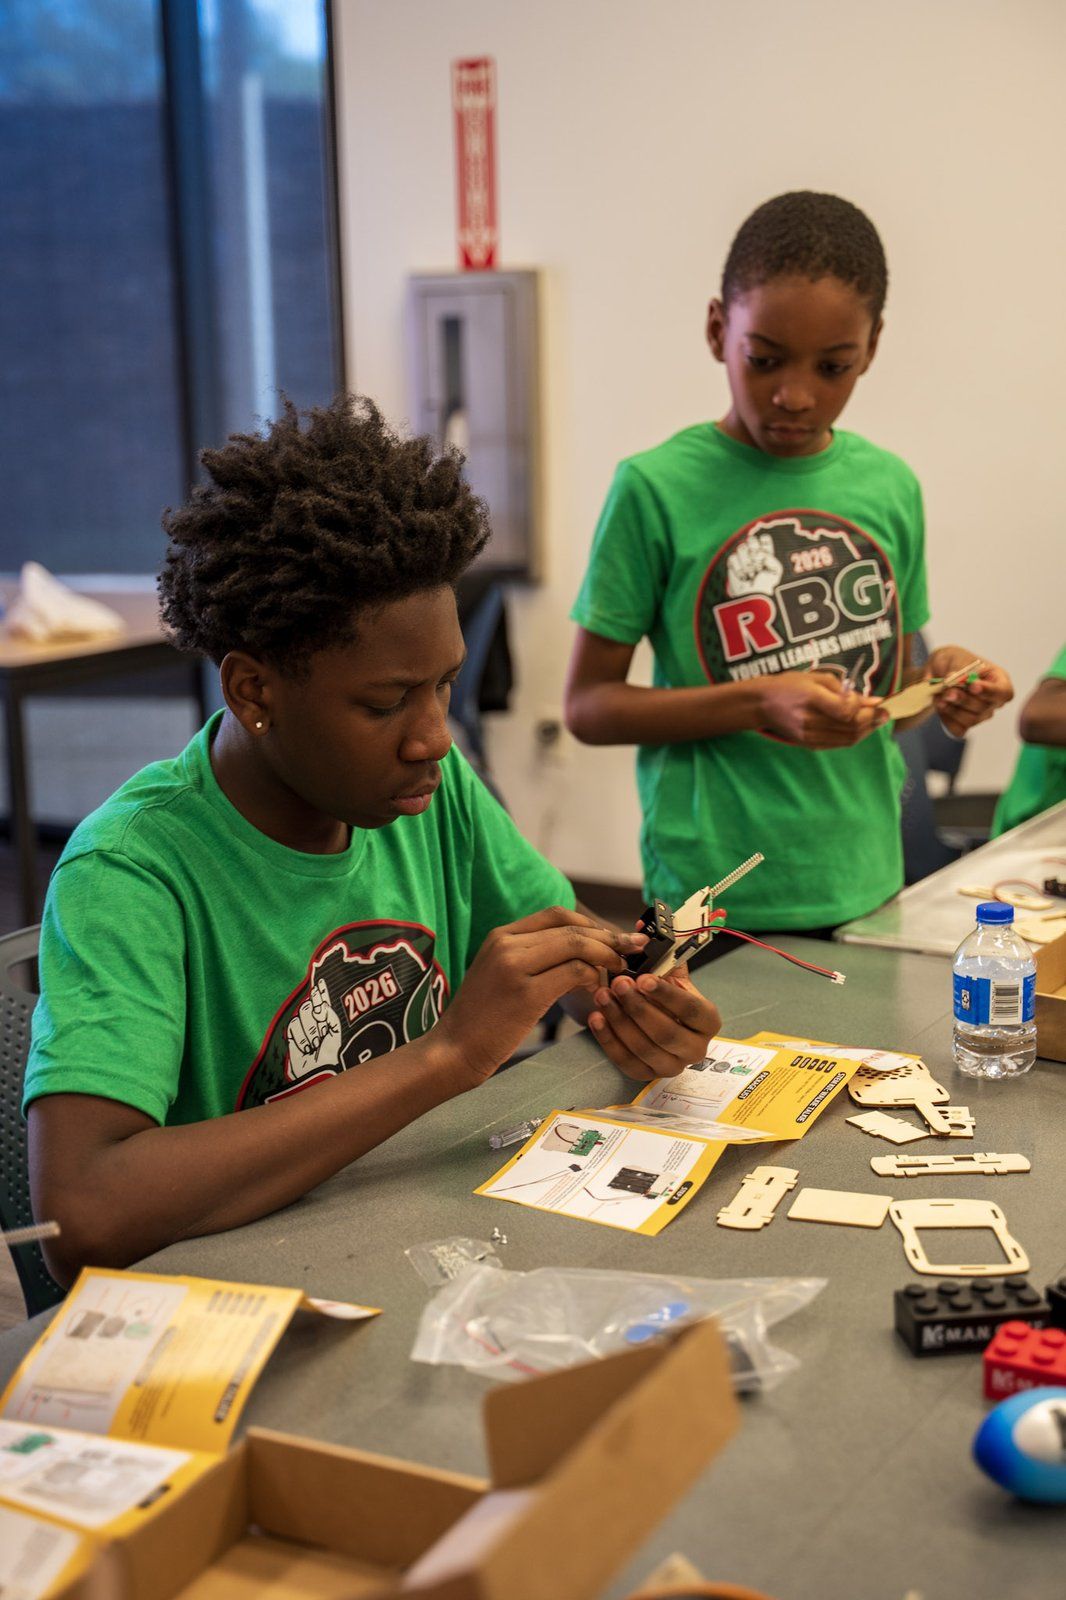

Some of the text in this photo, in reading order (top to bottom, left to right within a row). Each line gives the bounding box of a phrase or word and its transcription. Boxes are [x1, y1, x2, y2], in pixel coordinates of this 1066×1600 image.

[791, 546, 833, 574] 2026
[713, 559, 888, 662] RBG
[728, 654, 781, 682] YOUTH
[343, 971, 399, 1022] 2026
